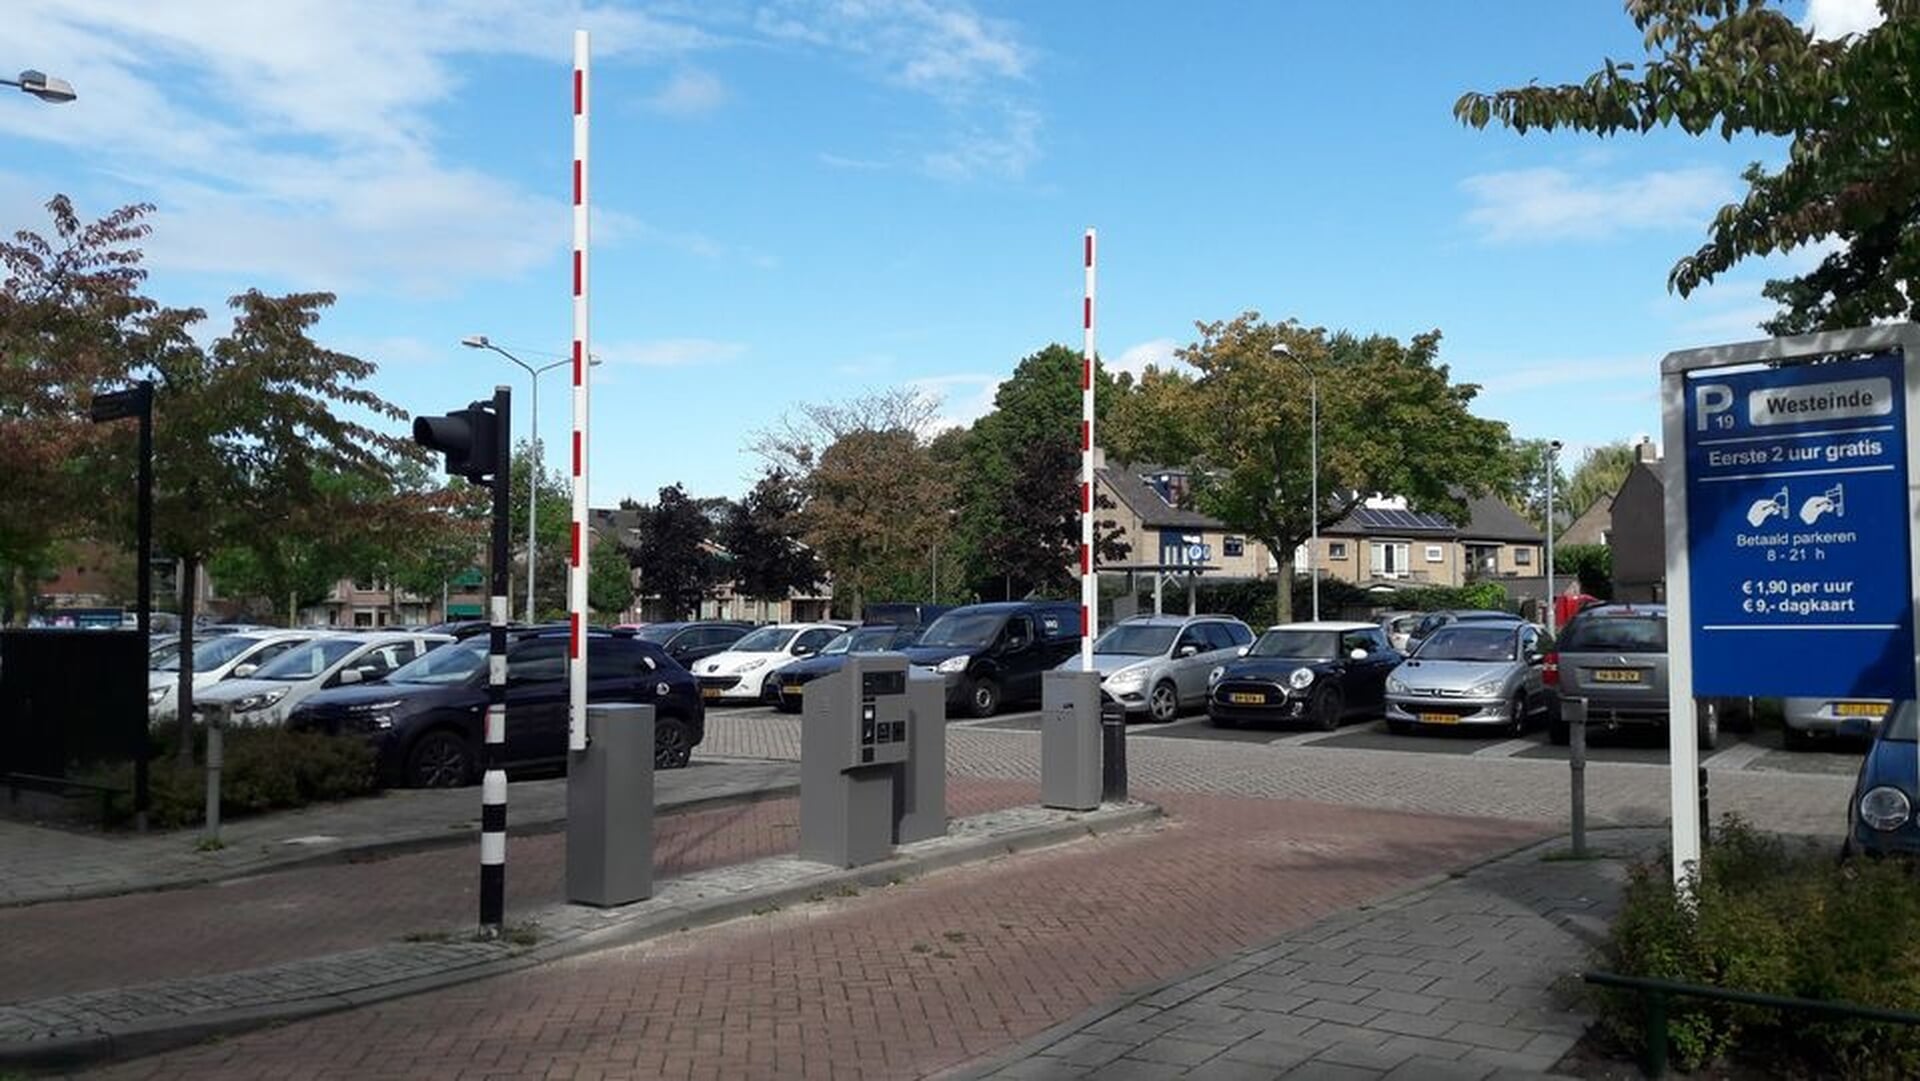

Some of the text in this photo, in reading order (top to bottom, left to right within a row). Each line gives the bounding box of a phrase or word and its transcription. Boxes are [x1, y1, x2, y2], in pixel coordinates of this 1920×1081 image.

[1695, 384, 1735, 431] P 19
[1767, 390, 1873, 415] Westeinde
[1709, 439, 1883, 467] Eerste 2 uur gratis
[1736, 531, 1857, 547] Betaald parkeren
[1767, 549, 1777, 562] 8
[1789, 548, 1806, 561] 21
[1815, 547, 1825, 560] h
[1742, 580, 1854, 596] € 1,90 per uur
[1779, 598, 1855, 615] dagkaart
